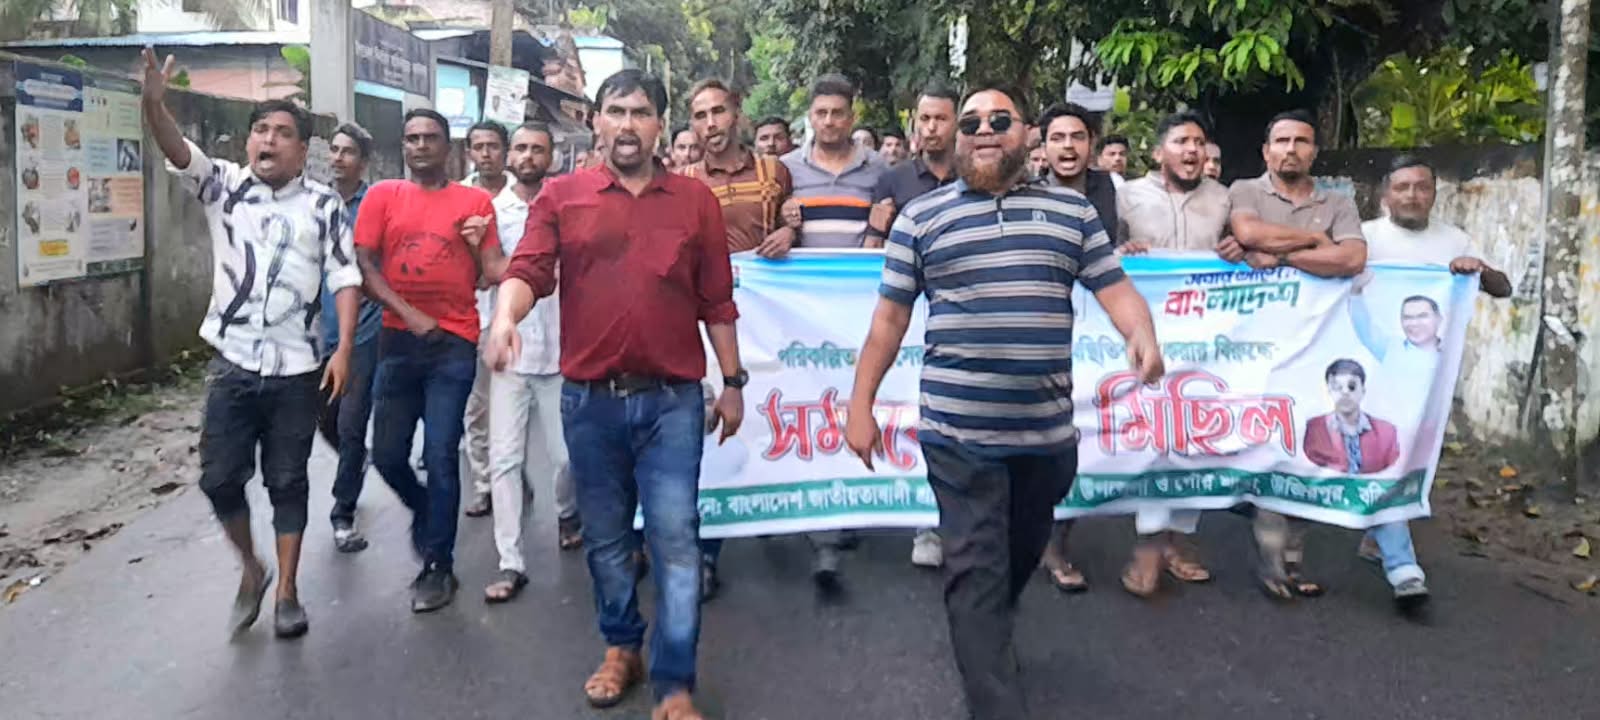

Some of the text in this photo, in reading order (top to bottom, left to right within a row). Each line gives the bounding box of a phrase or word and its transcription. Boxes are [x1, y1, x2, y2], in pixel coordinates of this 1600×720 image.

[1164, 281, 1300, 317] বাংলাদেশ
[1092, 369, 1297, 457] মিছিল
[726, 489, 802, 517] বাংলাদেশ
